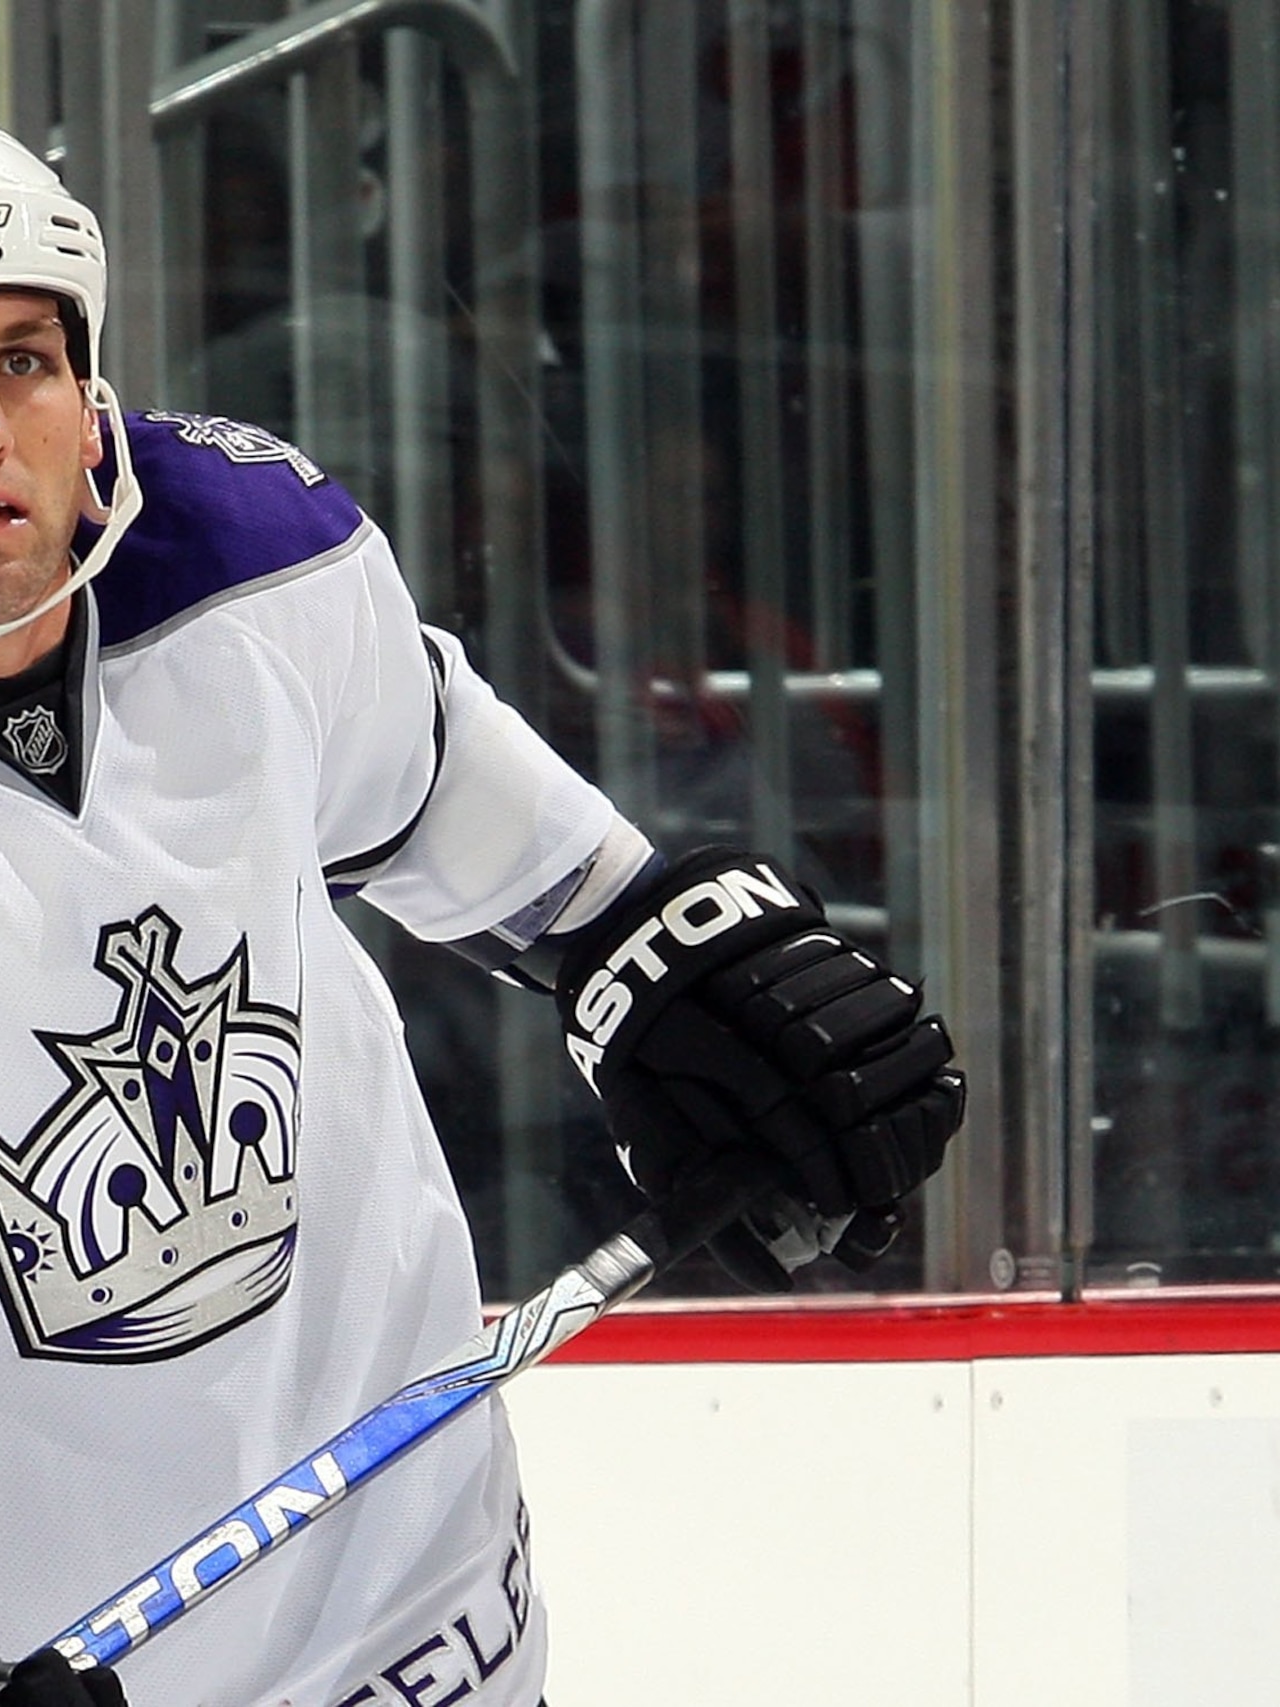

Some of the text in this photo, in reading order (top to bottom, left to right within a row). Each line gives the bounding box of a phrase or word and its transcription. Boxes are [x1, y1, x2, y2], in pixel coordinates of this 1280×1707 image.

[27, 722, 53, 764] NHL
[566, 863, 800, 1101] ASTON
[332, 1493, 531, 1707] ELE
